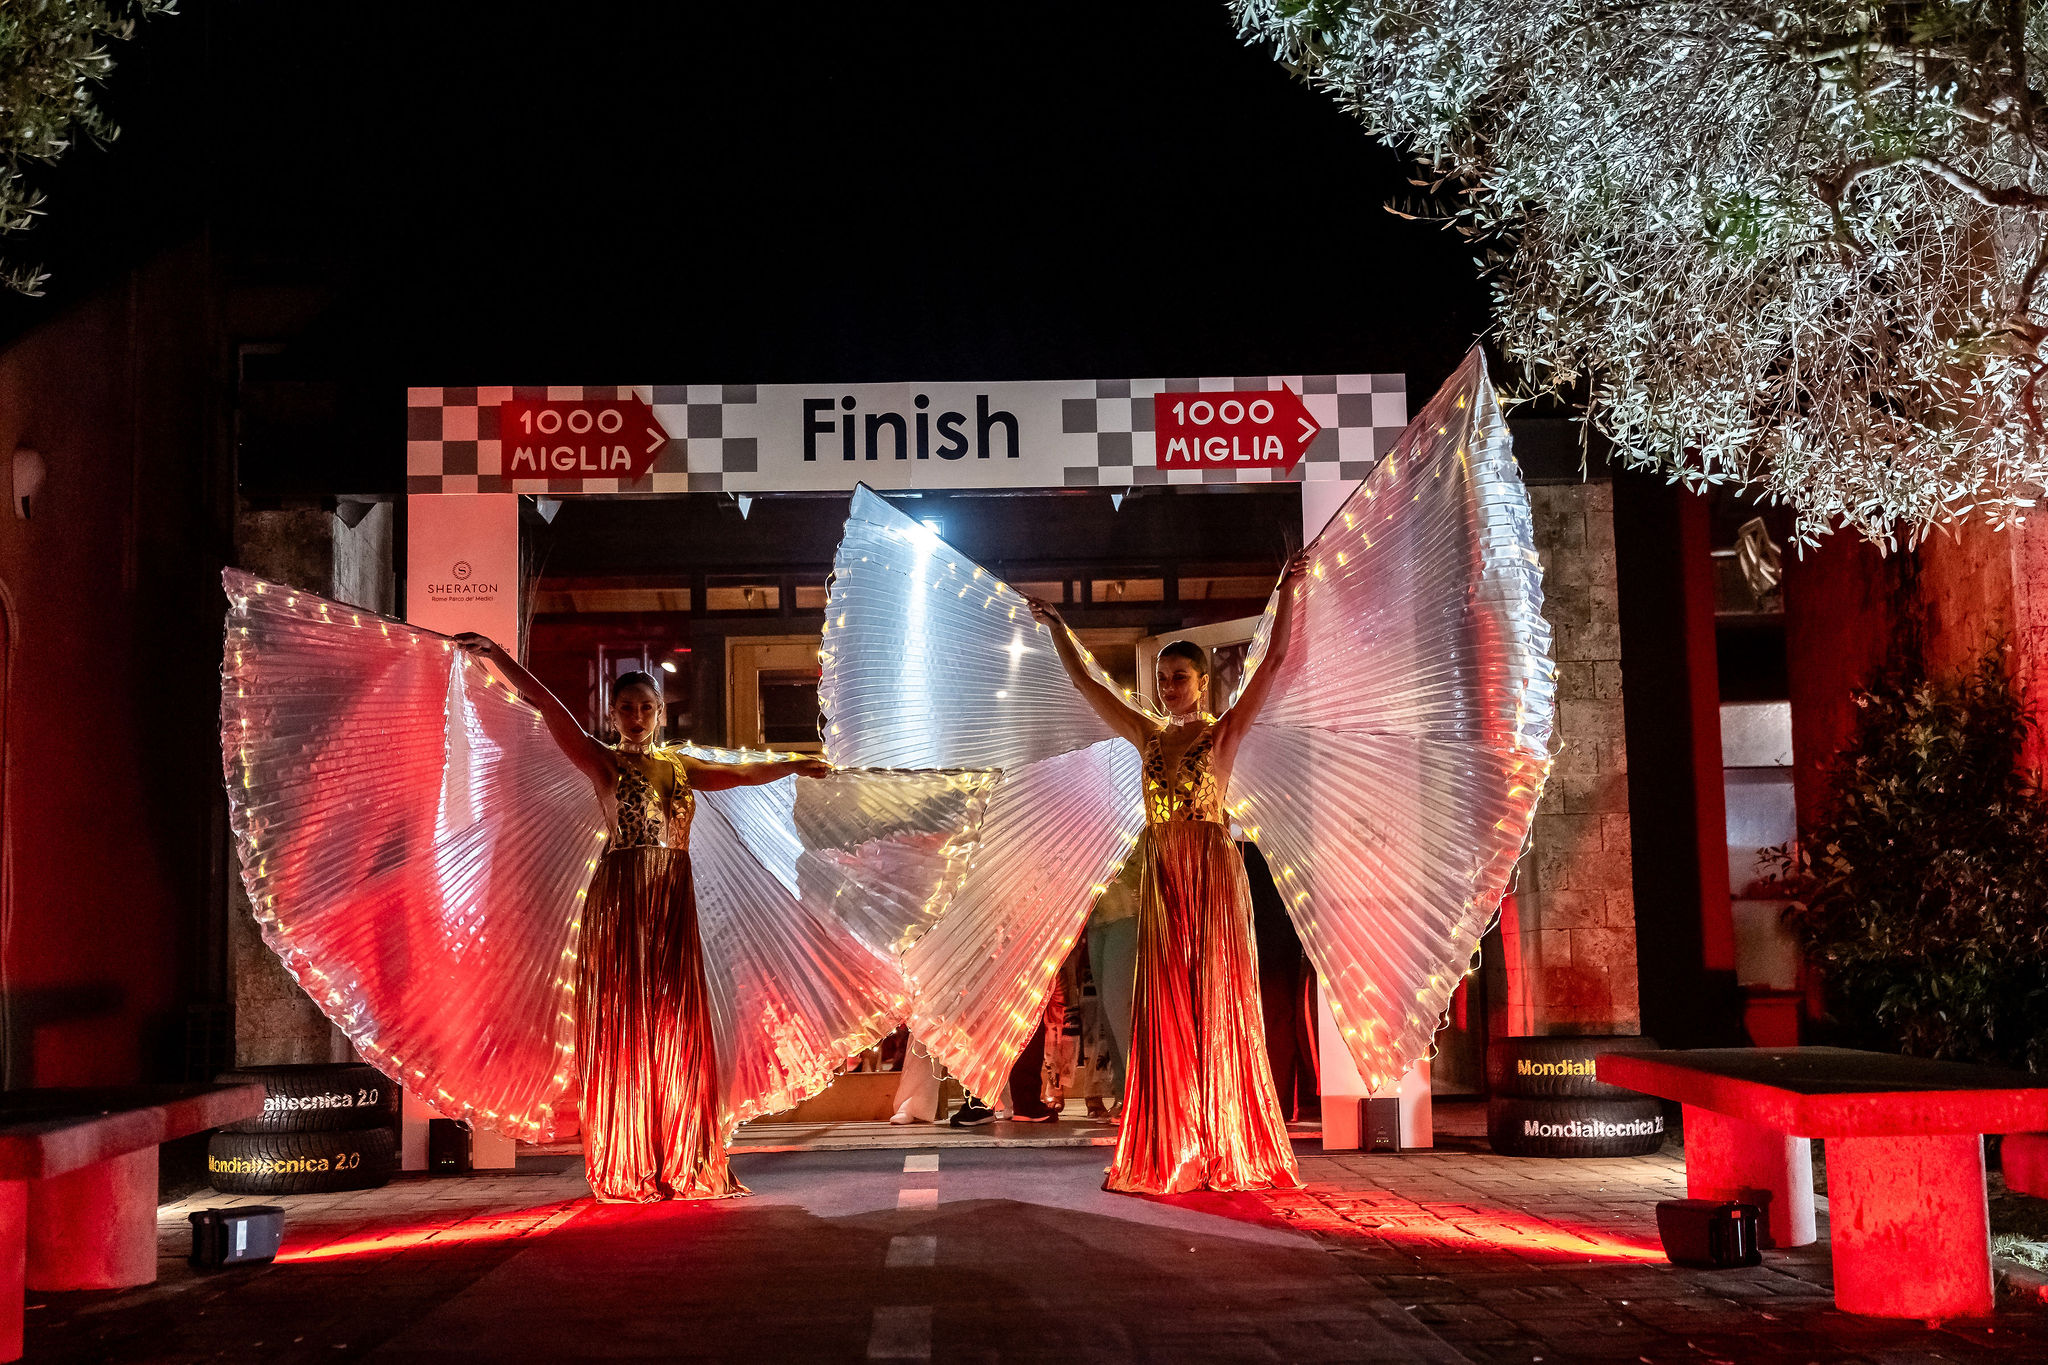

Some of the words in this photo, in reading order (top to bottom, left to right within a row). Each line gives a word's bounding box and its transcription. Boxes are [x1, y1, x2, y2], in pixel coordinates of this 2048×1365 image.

[520, 409, 623, 435] 1000
[1172, 400, 1274, 426] 1000
[803, 394, 1020, 462] Finish
[511, 446, 632, 471] MIGLIA
[1165, 435, 1284, 461] MIGLIA
[427, 583, 498, 594] SHERATON
[356, 1088, 379, 1107] 2.0
[1524, 1118, 1654, 1138] Mondialtecnica
[208, 1153, 329, 1174] Mondialtecnica
[335, 1151, 360, 1171] 2.0
